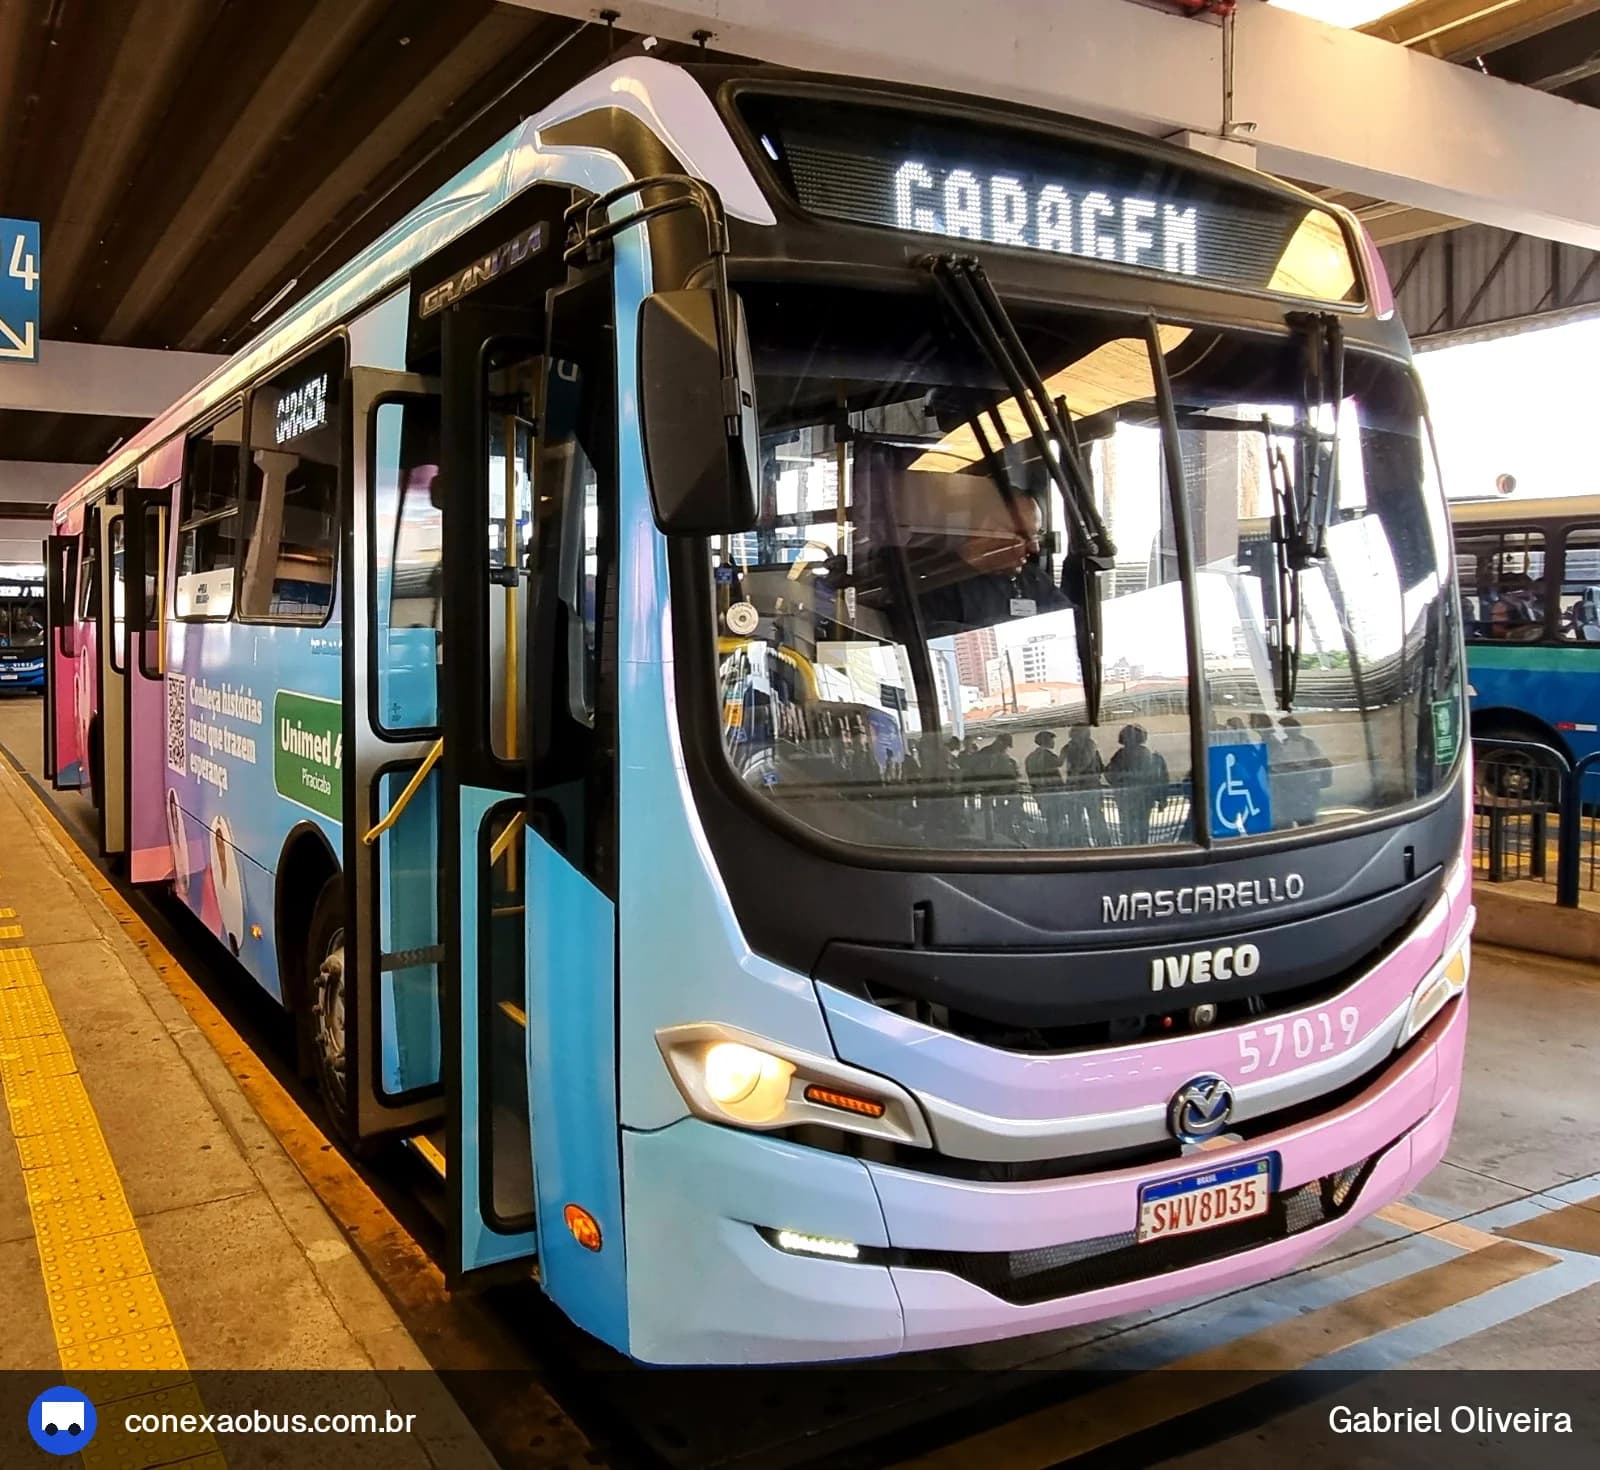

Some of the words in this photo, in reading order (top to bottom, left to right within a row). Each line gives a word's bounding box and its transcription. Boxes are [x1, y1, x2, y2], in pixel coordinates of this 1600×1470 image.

[9, 234, 39, 291] 4
[190, 678, 221, 720] Conheça
[222, 682, 263, 725] histórias
[189, 713, 207, 744] reais
[208, 725, 223, 757] que
[223, 725, 257, 764] trazem
[281, 718, 331, 767] Unimed
[189, 752, 228, 798] esperança
[301, 767, 332, 796] Piracicaba
[1102, 873, 1305, 924] MASCARELLO
[1151, 943, 1261, 992] IVECO
[1238, 1006, 1360, 1075] 57019
[1151, 1180, 1257, 1234] SWV8D35
